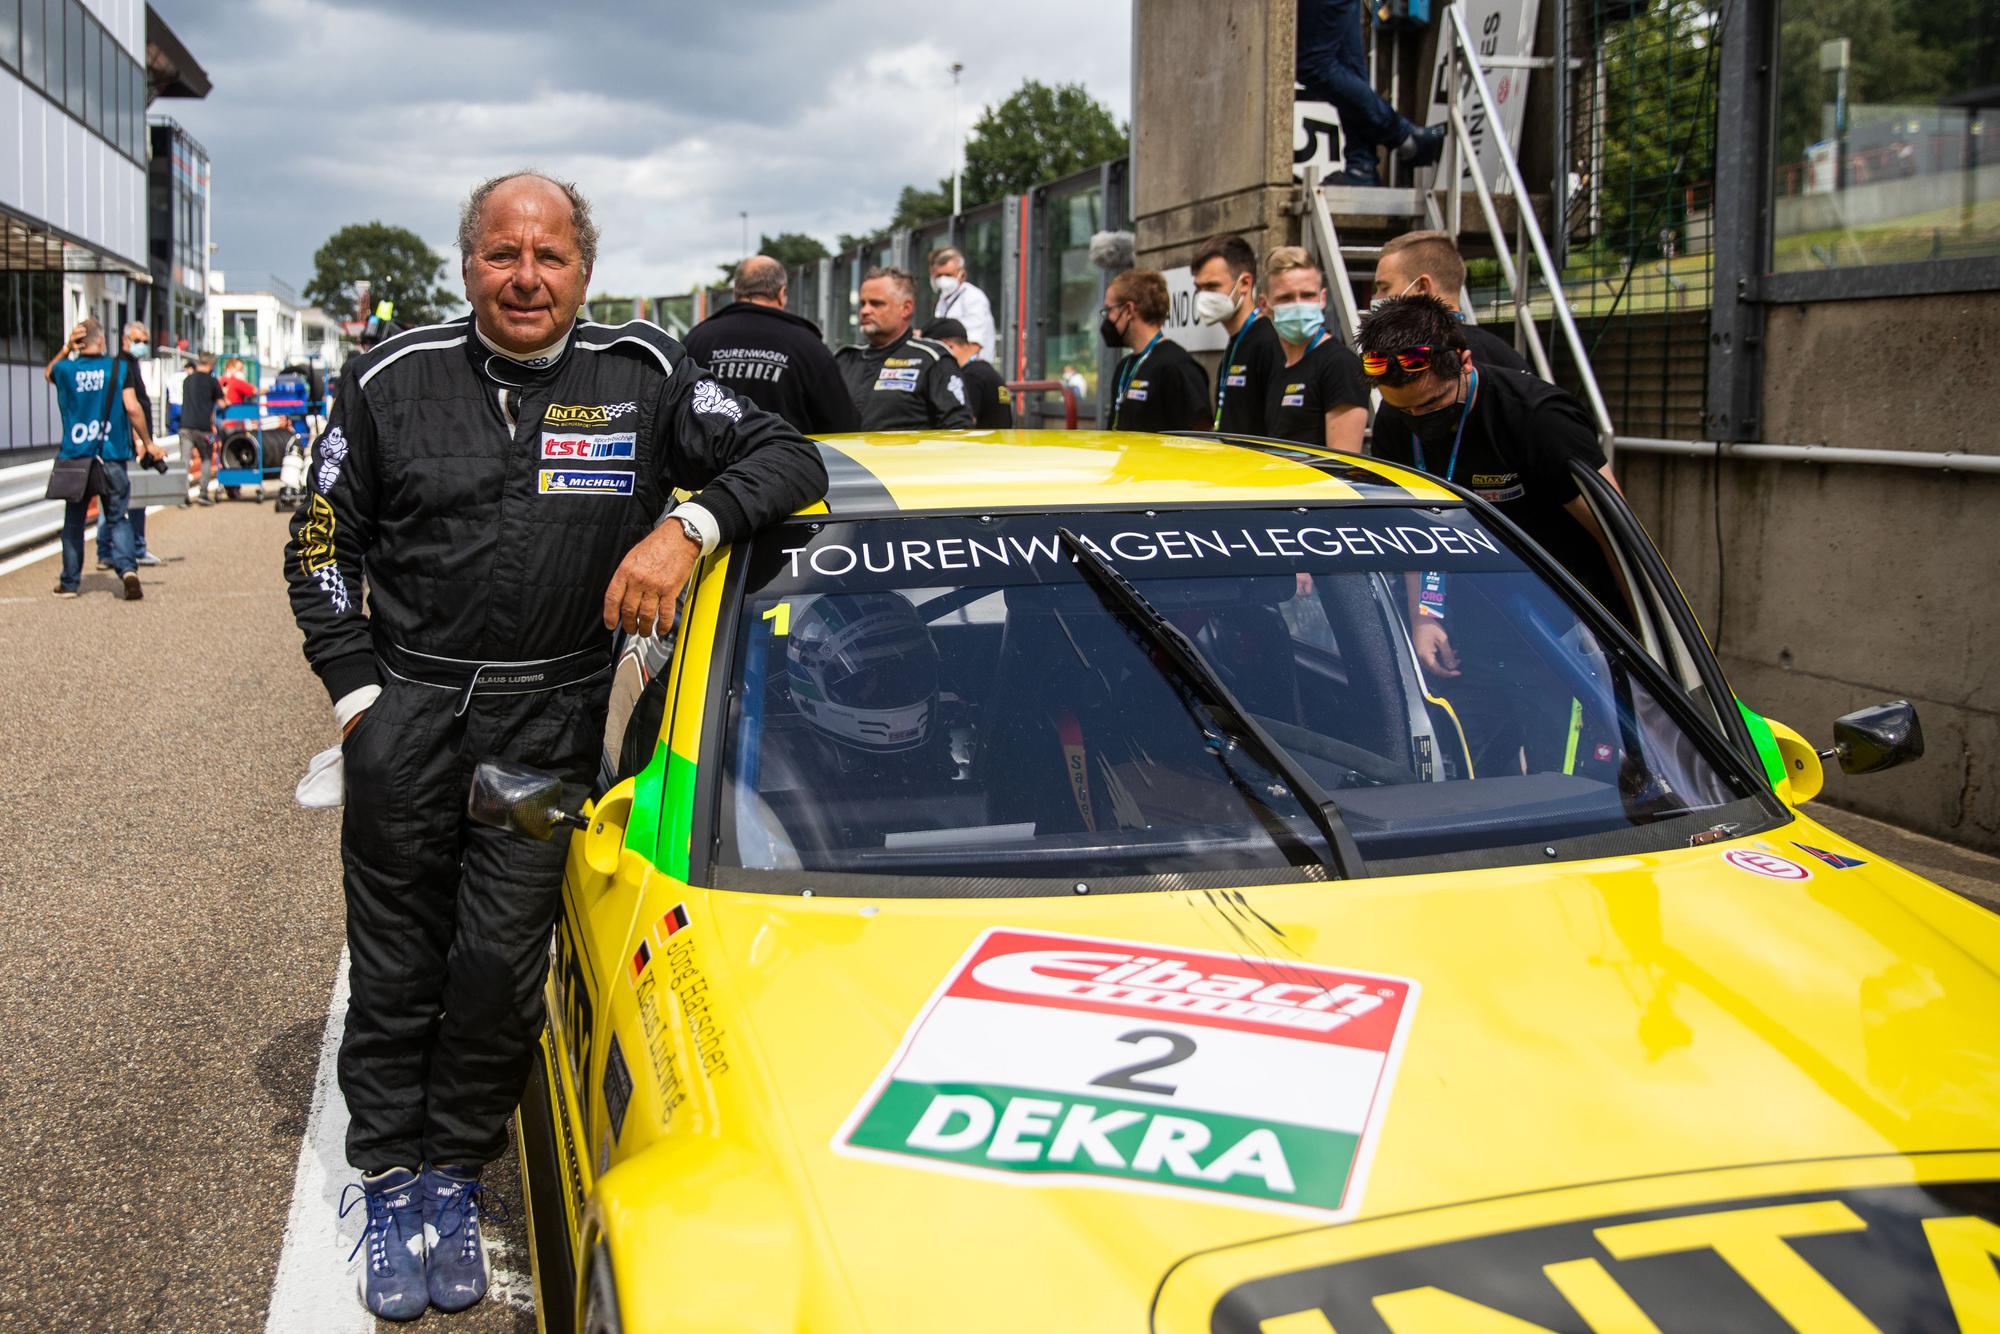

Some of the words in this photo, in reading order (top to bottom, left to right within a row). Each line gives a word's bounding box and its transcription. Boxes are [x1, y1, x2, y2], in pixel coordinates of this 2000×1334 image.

[712, 348, 788, 364] TOURENWAGEN
[75, 369, 105, 381] DTM
[551, 407, 602, 420] INTAX
[544, 438, 592, 457] tst
[568, 478, 628, 488] MICHELIN
[782, 527, 1500, 578] TOURENWAGEN-LEGENDEN
[1421, 590, 1445, 602] ORG
[762, 603, 790, 637] 1
[476, 676, 506, 684] KLAUS
[508, 673, 544, 684] LUDWIG
[666, 938, 701, 992] Jörg
[679, 977, 731, 1079] Hatscher
[1088, 1028, 1198, 1096] 2
[905, 1093, 1296, 1193] DEKRA
